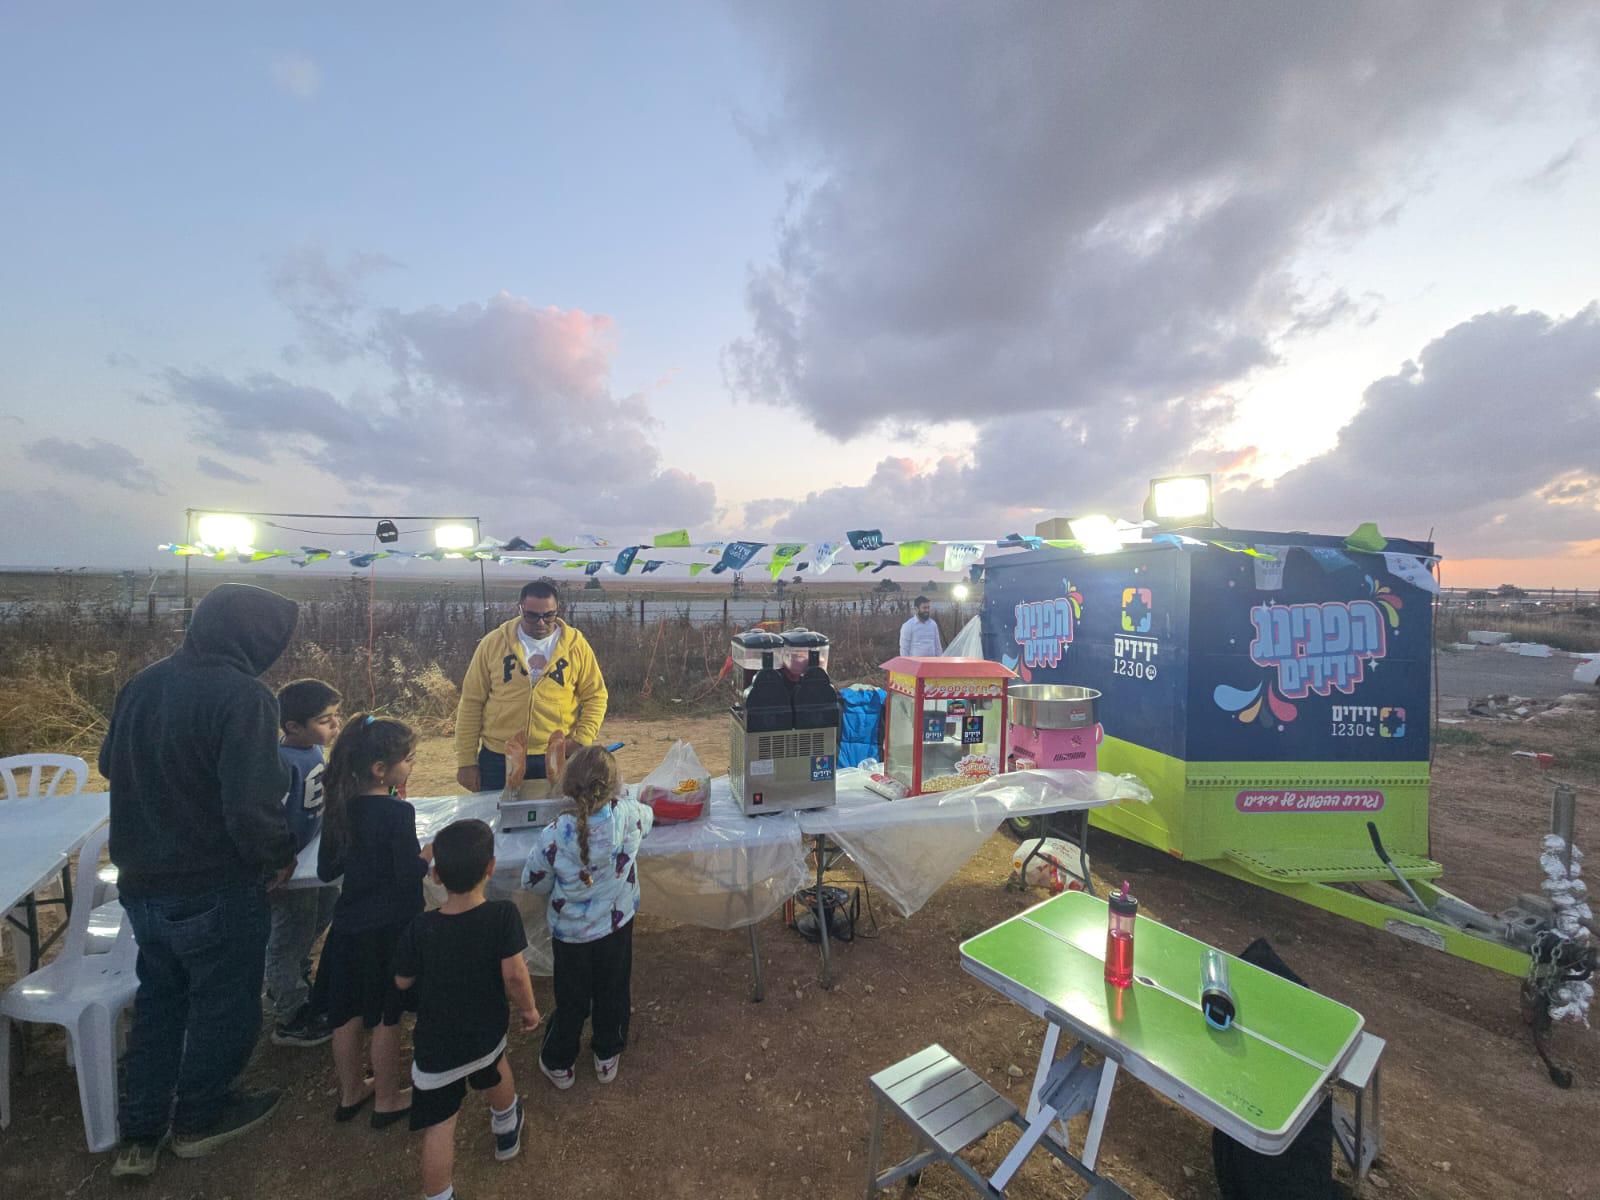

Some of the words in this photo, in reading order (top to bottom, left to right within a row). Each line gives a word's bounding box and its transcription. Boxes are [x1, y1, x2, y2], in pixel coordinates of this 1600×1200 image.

[1015, 597, 1071, 640] הפנינג
[1252, 603, 1381, 659] הפנינג
[1025, 637, 1060, 664] ידידים
[1114, 637, 1159, 662] ידידים
[1113, 657, 1144, 679] 1230
[1281, 654, 1357, 692] ידידים
[1332, 705, 1378, 723] ידידים
[1331, 723, 1365, 737] 1230
[1244, 795, 1279, 808] ידידים
[1281, 791, 1297, 807] של
